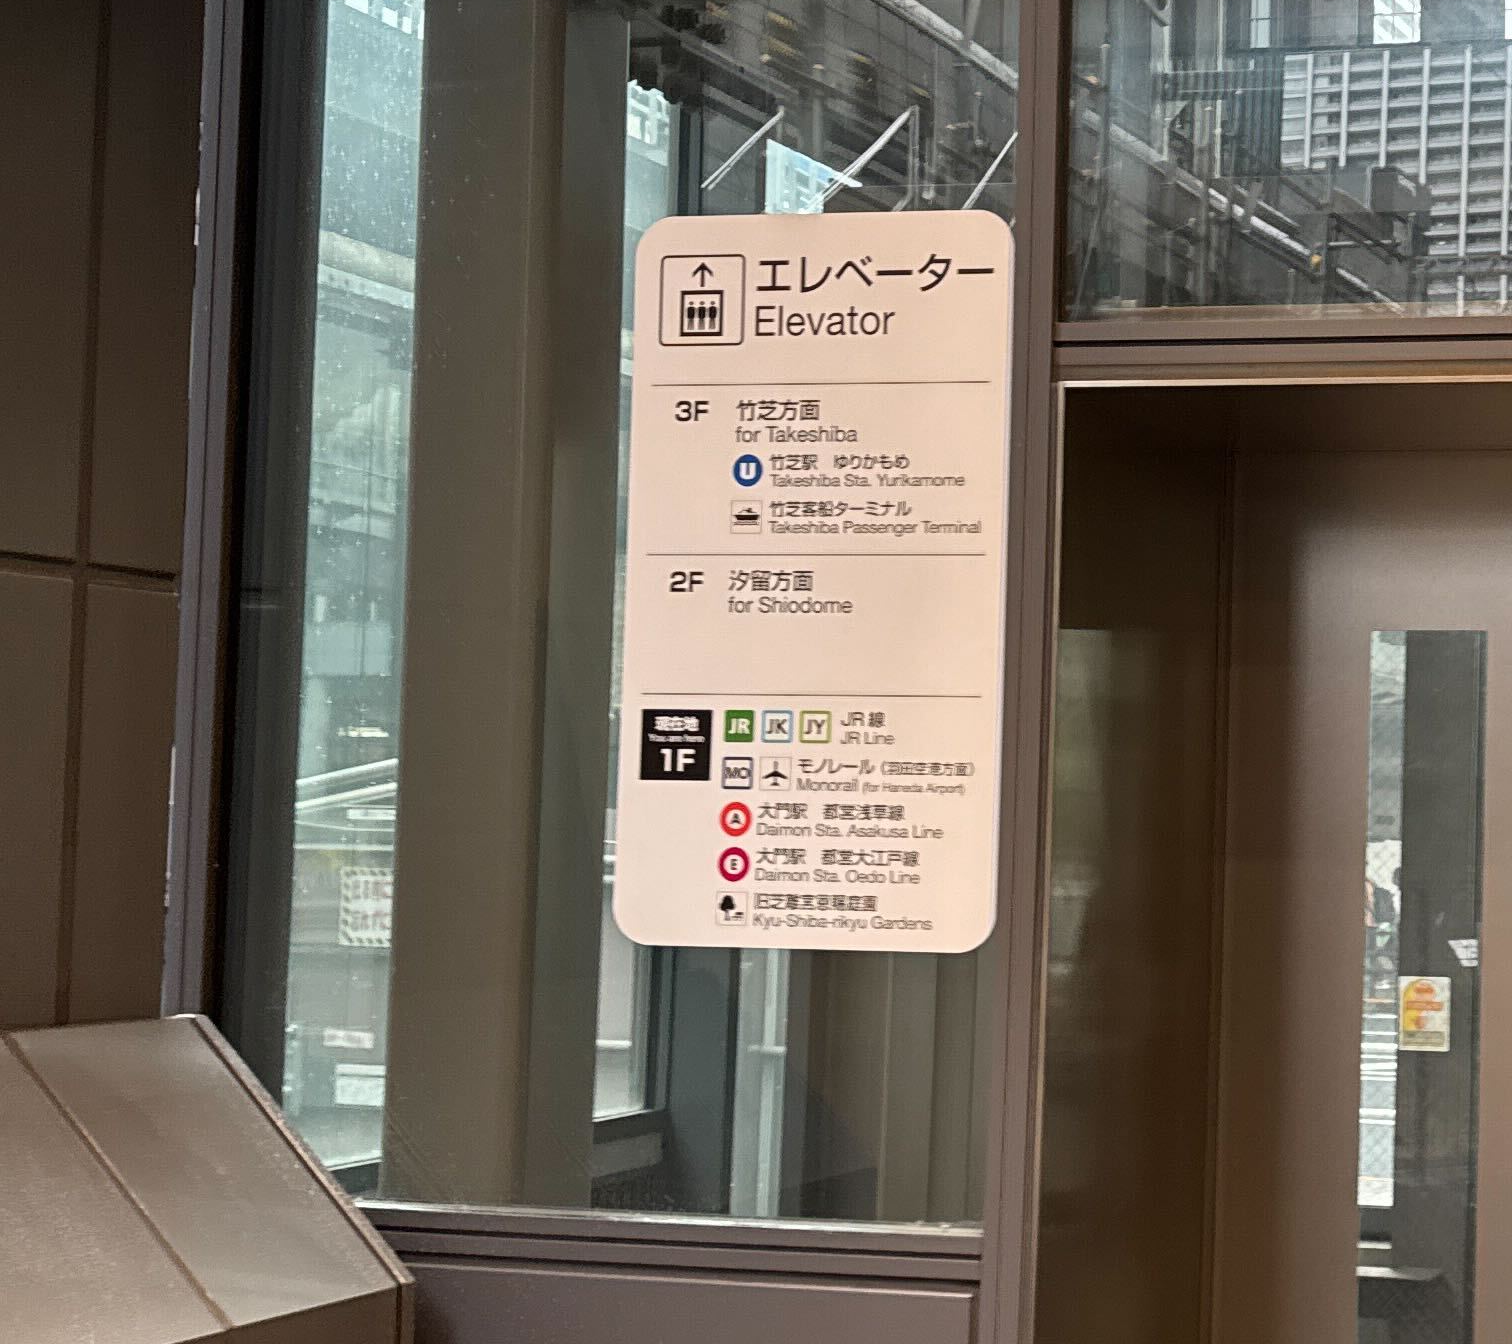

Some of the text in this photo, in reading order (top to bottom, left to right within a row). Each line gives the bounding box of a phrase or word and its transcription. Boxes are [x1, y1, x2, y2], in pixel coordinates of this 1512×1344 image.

[756, 253, 995, 293] エレベーター
[754, 305, 896, 337] Elevator
[674, 400, 710, 423] 3F
[736, 399, 821, 422] 竹芝方面
[735, 425, 858, 443] for Takeshiba
[770, 455, 910, 471] 竹芝駅 ゆりかもめ
[770, 473, 965, 488] Takeshiba Sta. Yurikamome
[770, 501, 912, 518] 竹芝客船ターミナル
[769, 520, 983, 538] Takeshiba Passenger Terminal
[669, 571, 705, 593] 2F
[727, 570, 815, 592] 汐留方面
[727, 597, 854, 614] for Shiodome
[727, 719, 826, 735] JR JK JY
[840, 731, 896, 746] JR Line
[660, 748, 697, 772] 1F
[797, 758, 876, 776] モノレール
[796, 777, 859, 793] Monorail
[757, 802, 809, 820] 大門駅
[755, 823, 945, 839] Daimon Sta. Asakusa Line
[755, 847, 807, 865] 大門駅
[753, 867, 921, 884] Daimon Sta. Oedo Line
[870, 915, 934, 931] Gardens
